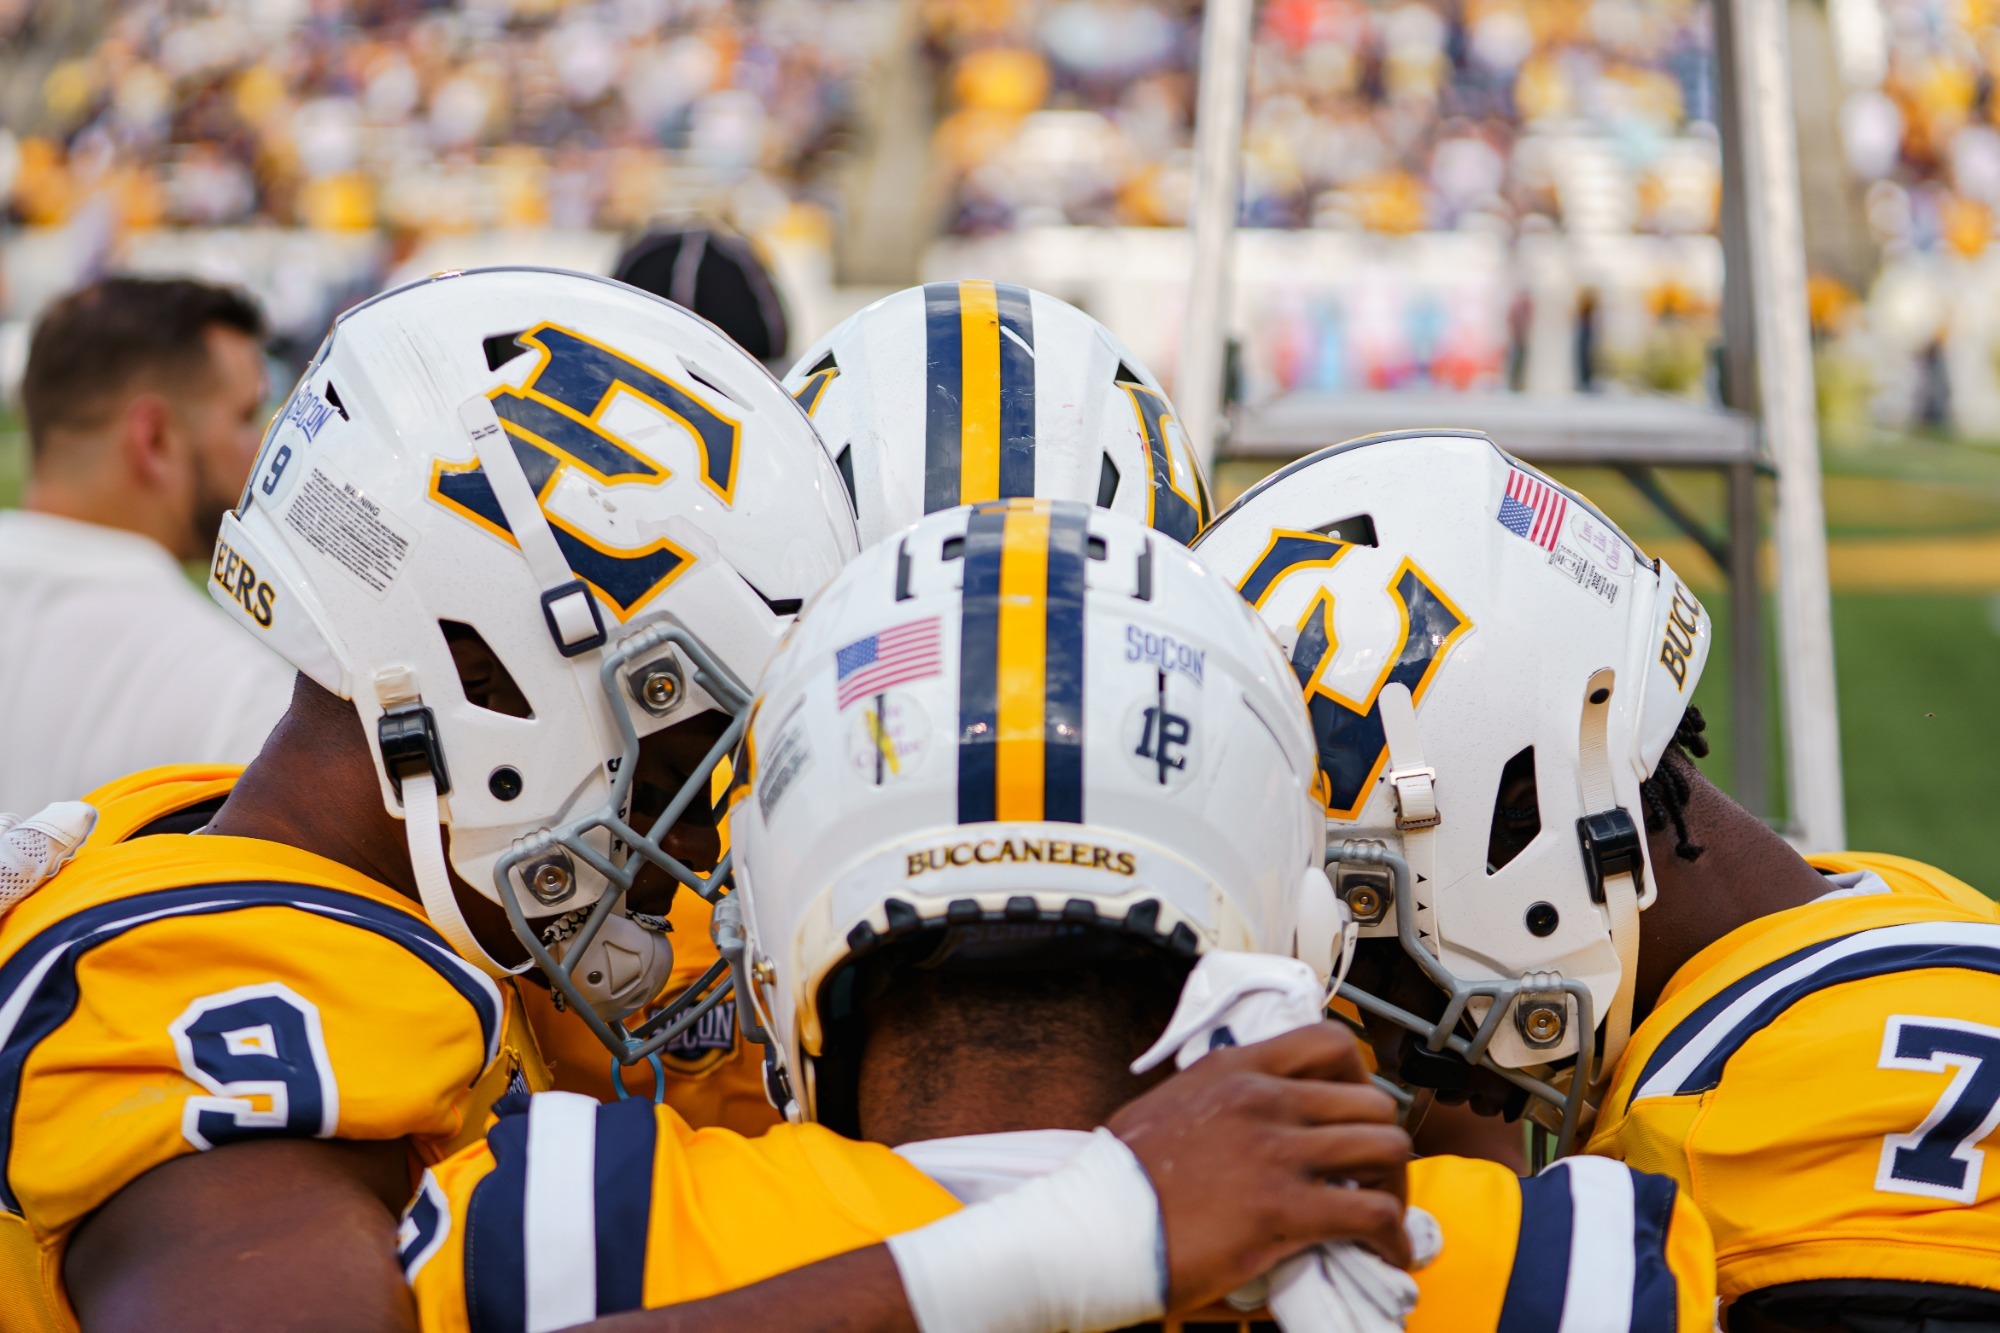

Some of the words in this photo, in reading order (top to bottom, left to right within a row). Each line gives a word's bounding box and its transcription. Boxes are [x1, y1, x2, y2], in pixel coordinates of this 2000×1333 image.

[262, 444, 291, 496] 9
[344, 482, 381, 517] WANING
[906, 840, 1136, 878] BUCCANEERS
[168, 982, 339, 1152] 9
[1875, 1014, 2000, 1205] 7
